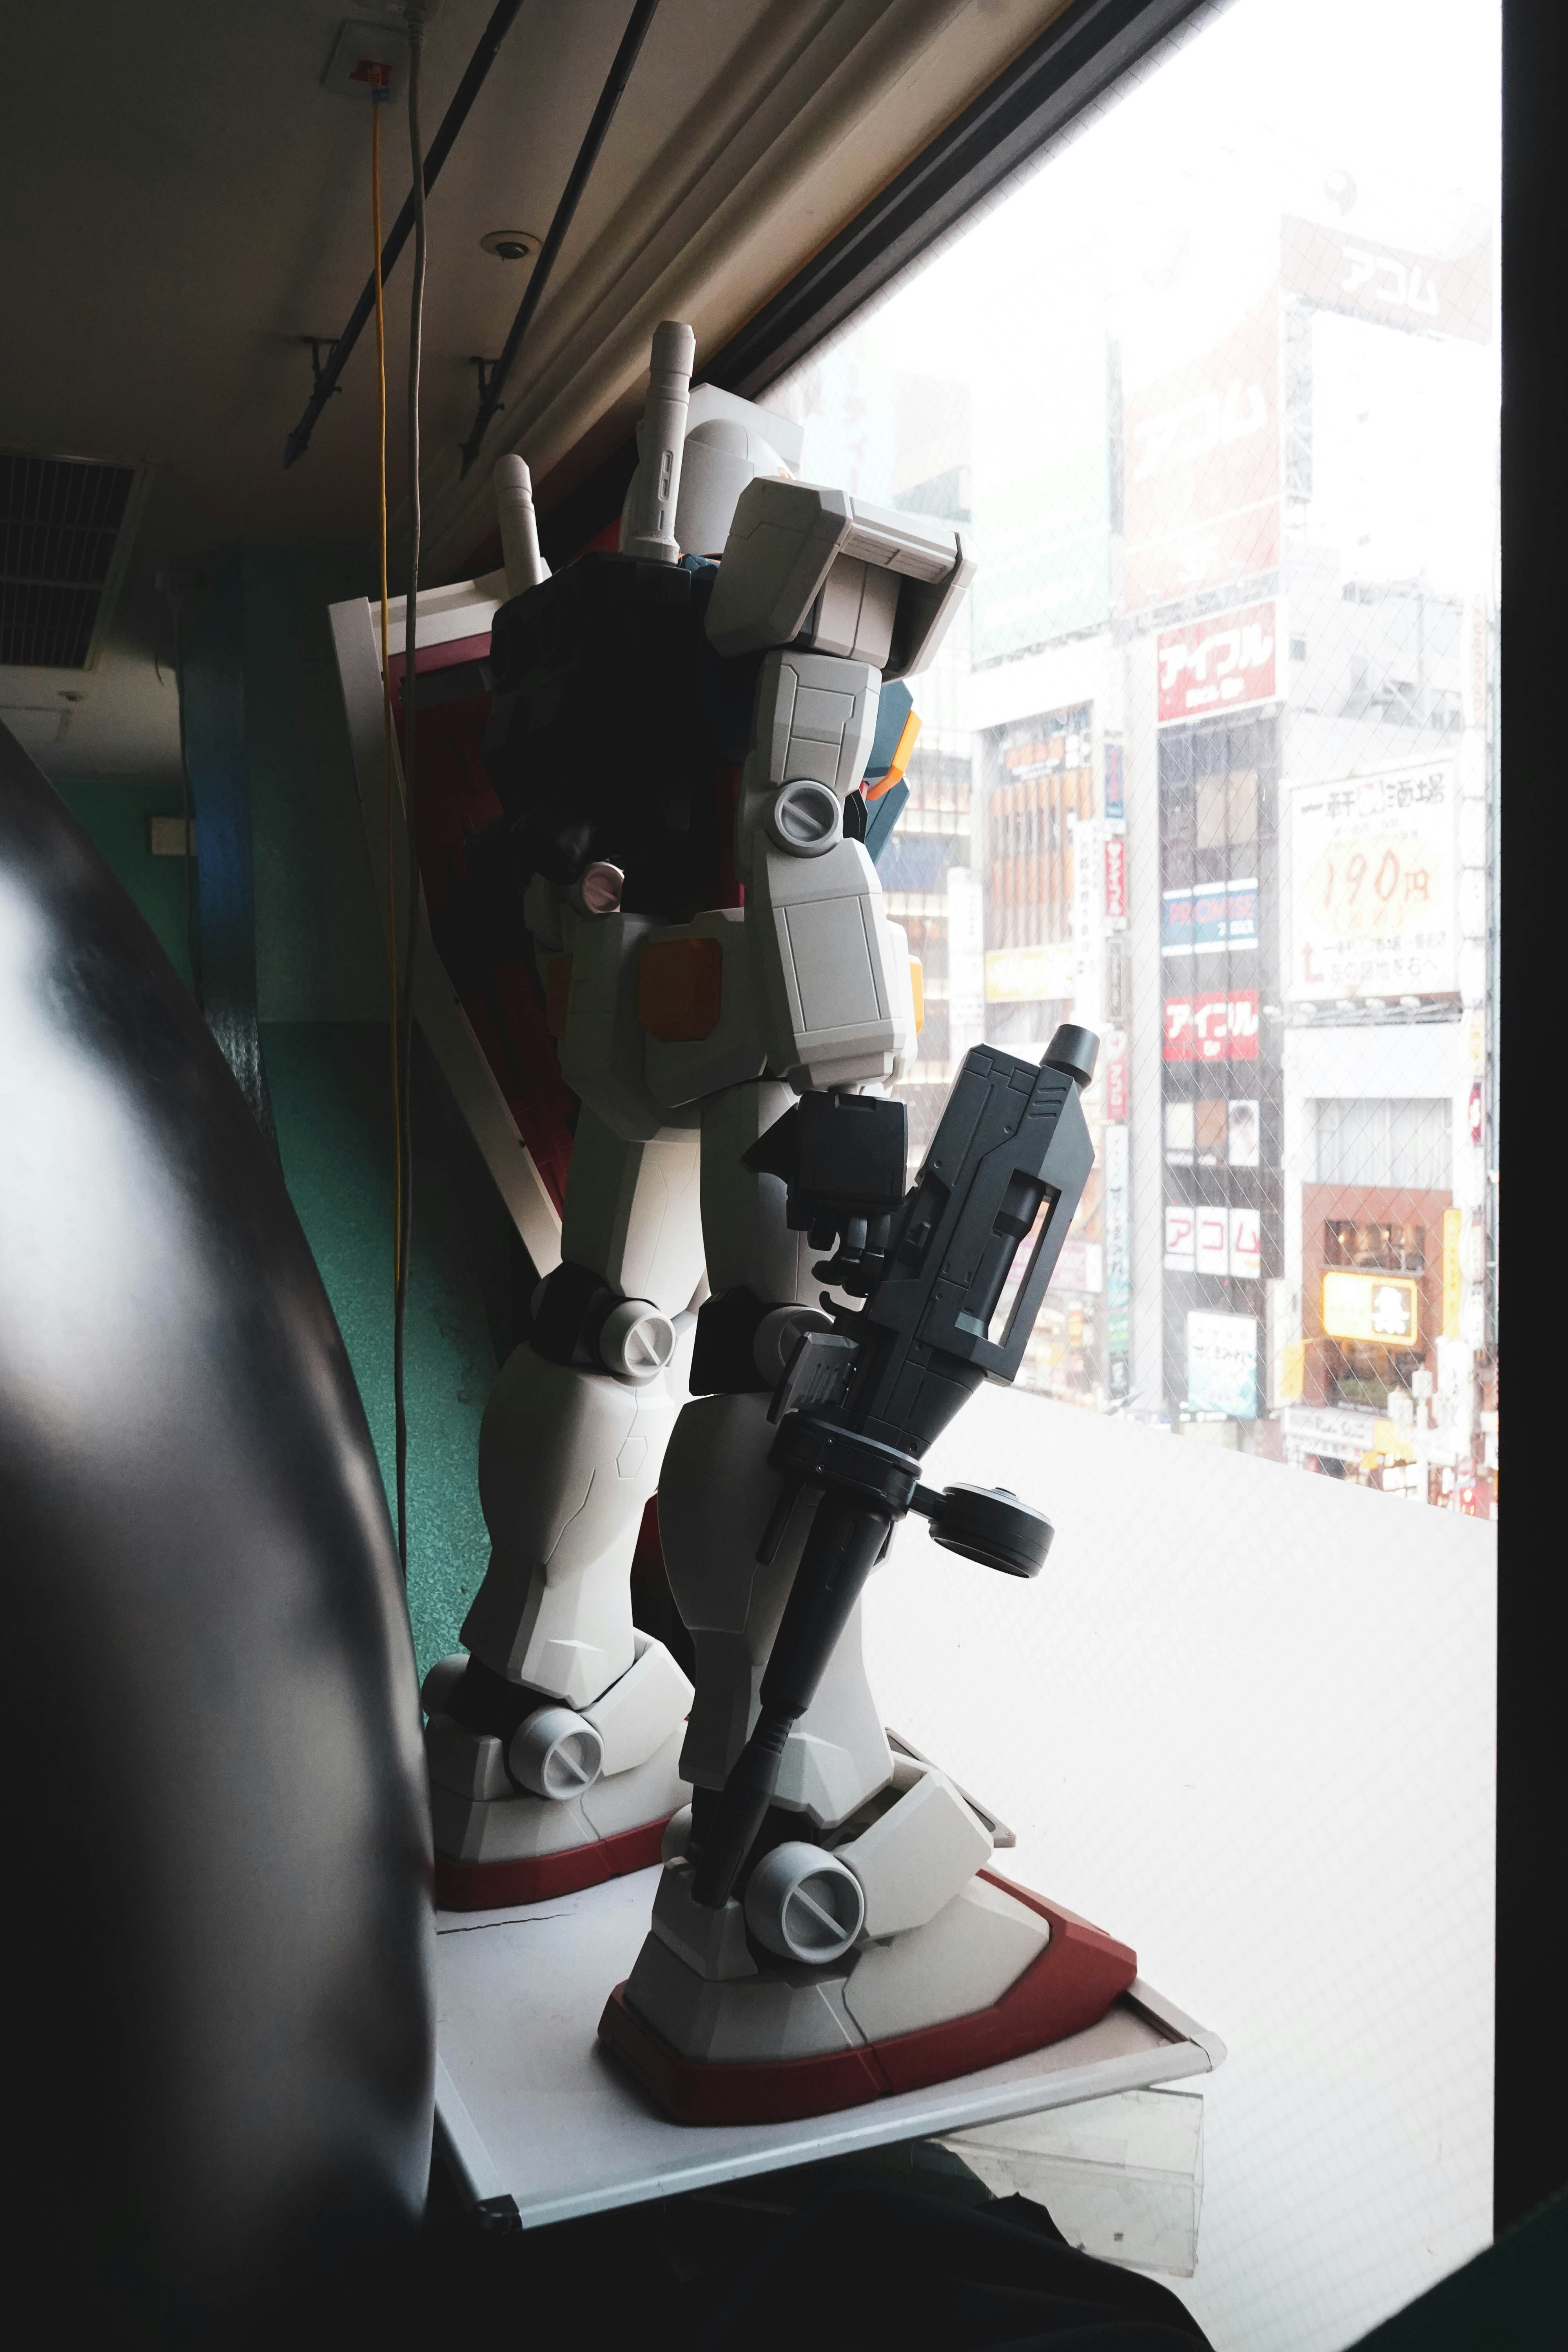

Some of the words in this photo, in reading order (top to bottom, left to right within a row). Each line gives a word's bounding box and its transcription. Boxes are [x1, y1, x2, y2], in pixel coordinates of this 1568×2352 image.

[1339, 244, 1439, 316] アコム
[1133, 377, 1269, 483] アコム
[1159, 622, 1273, 690] アイフル
[1301, 773, 1445, 818] 一軒酒場
[1323, 848, 1430, 909] 190円
[1168, 893, 1256, 926] PROMISE
[1166, 1001, 1259, 1038] アイフル
[1169, 1218, 1260, 1254] アコム
